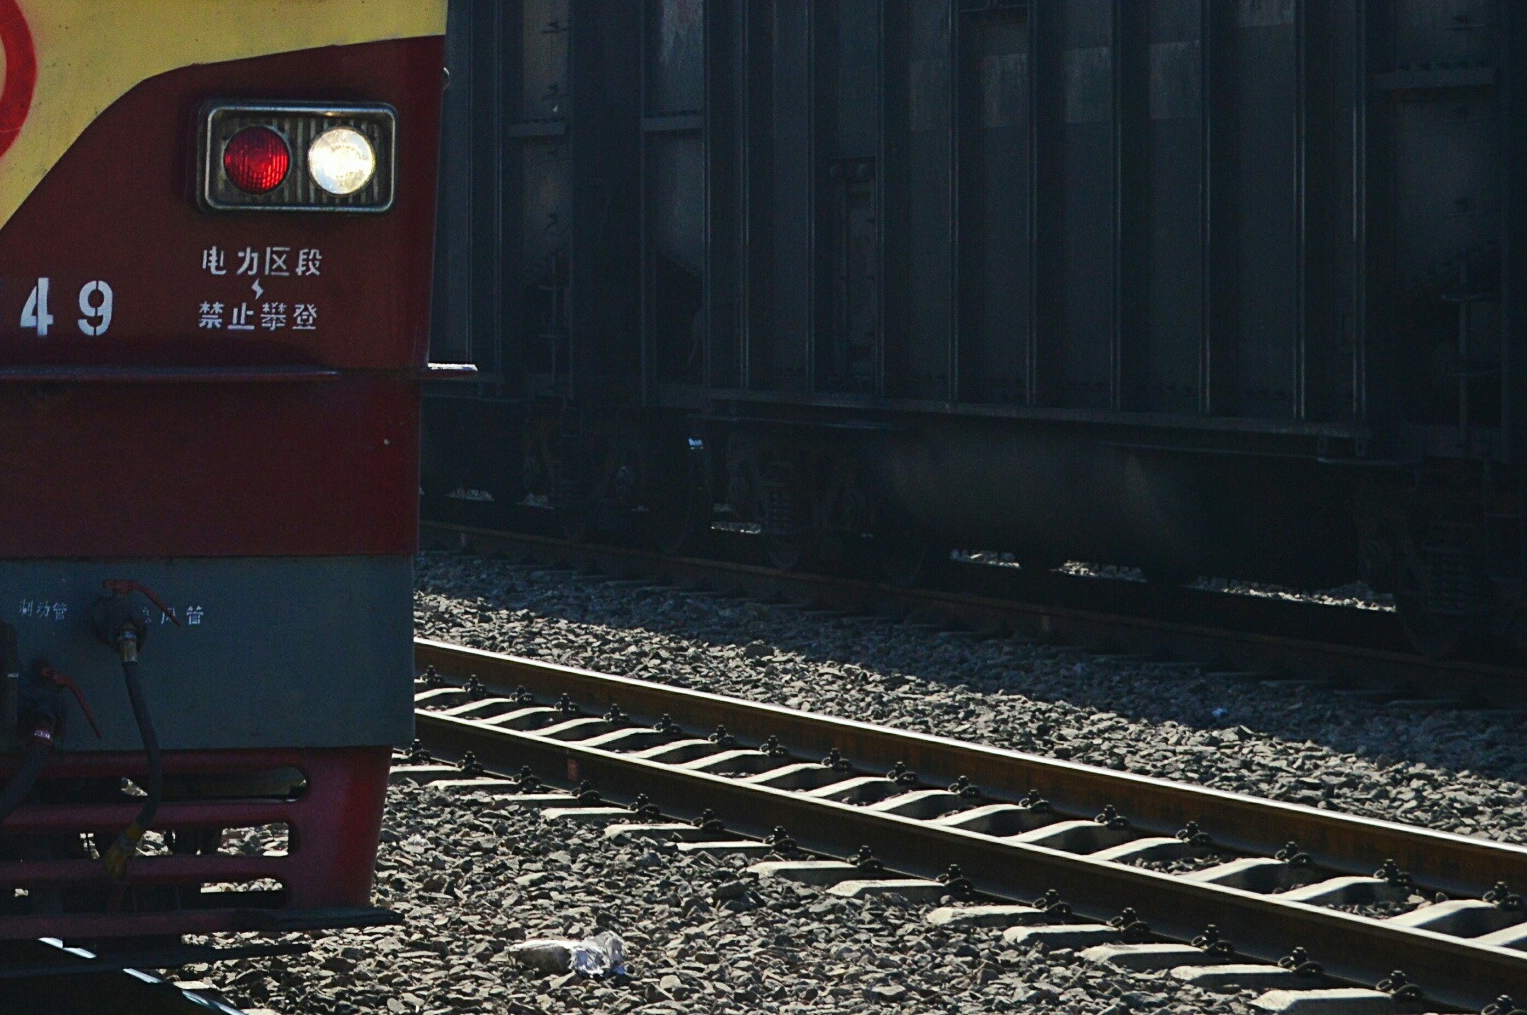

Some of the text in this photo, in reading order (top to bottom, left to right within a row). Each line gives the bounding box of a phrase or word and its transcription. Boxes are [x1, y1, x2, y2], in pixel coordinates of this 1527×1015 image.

[201, 246, 323, 276] 电力区段
[198, 300, 318, 331] 禁止攀登
[18, 598, 68, 621] 制动管
